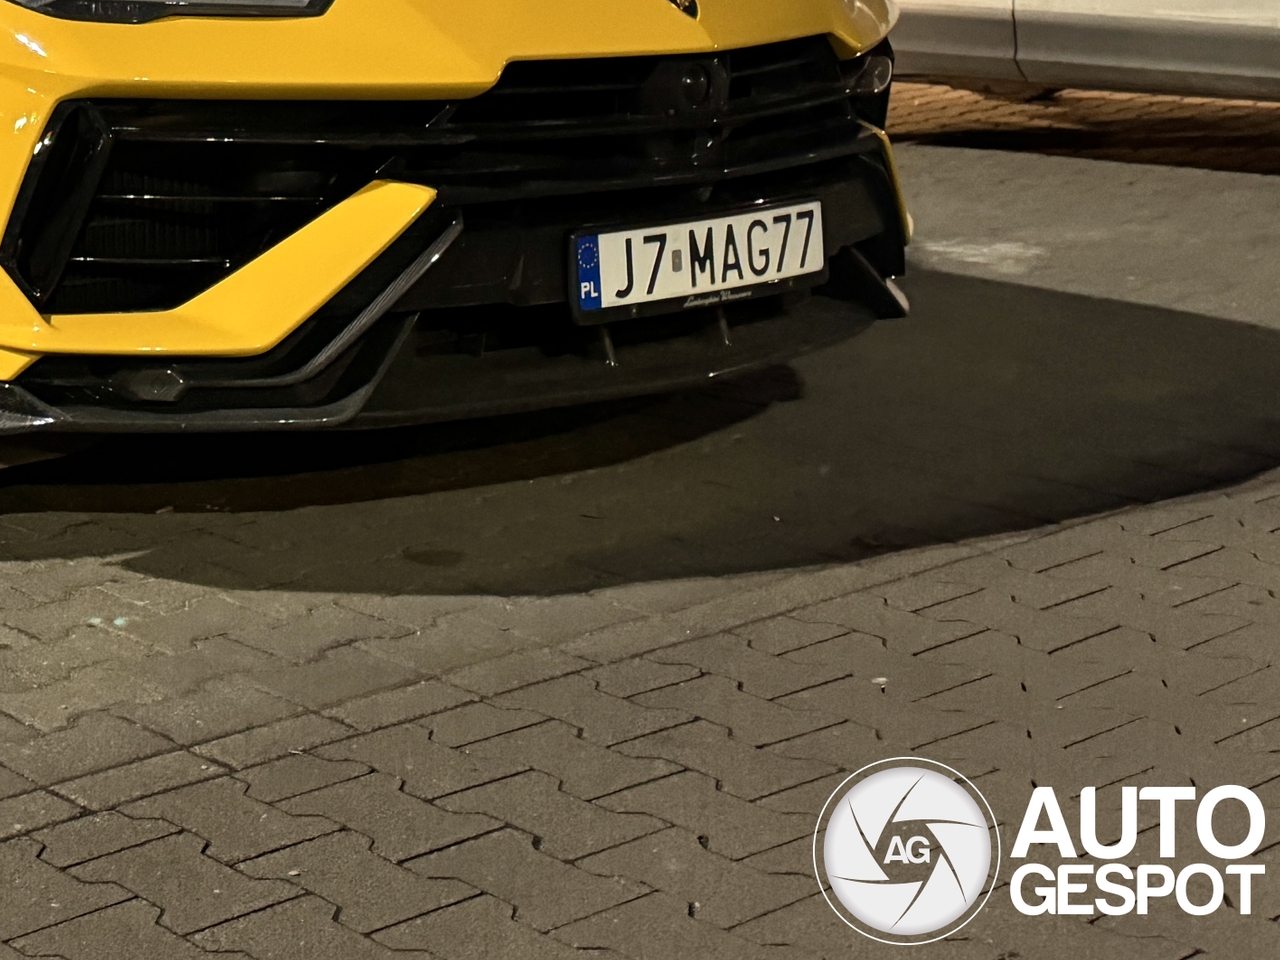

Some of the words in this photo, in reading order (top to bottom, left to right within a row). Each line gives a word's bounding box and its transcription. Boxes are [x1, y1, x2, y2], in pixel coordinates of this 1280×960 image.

[615, 232, 668, 299] J7
[688, 209, 814, 288] MAG77
[580, 281, 598, 299] PL
